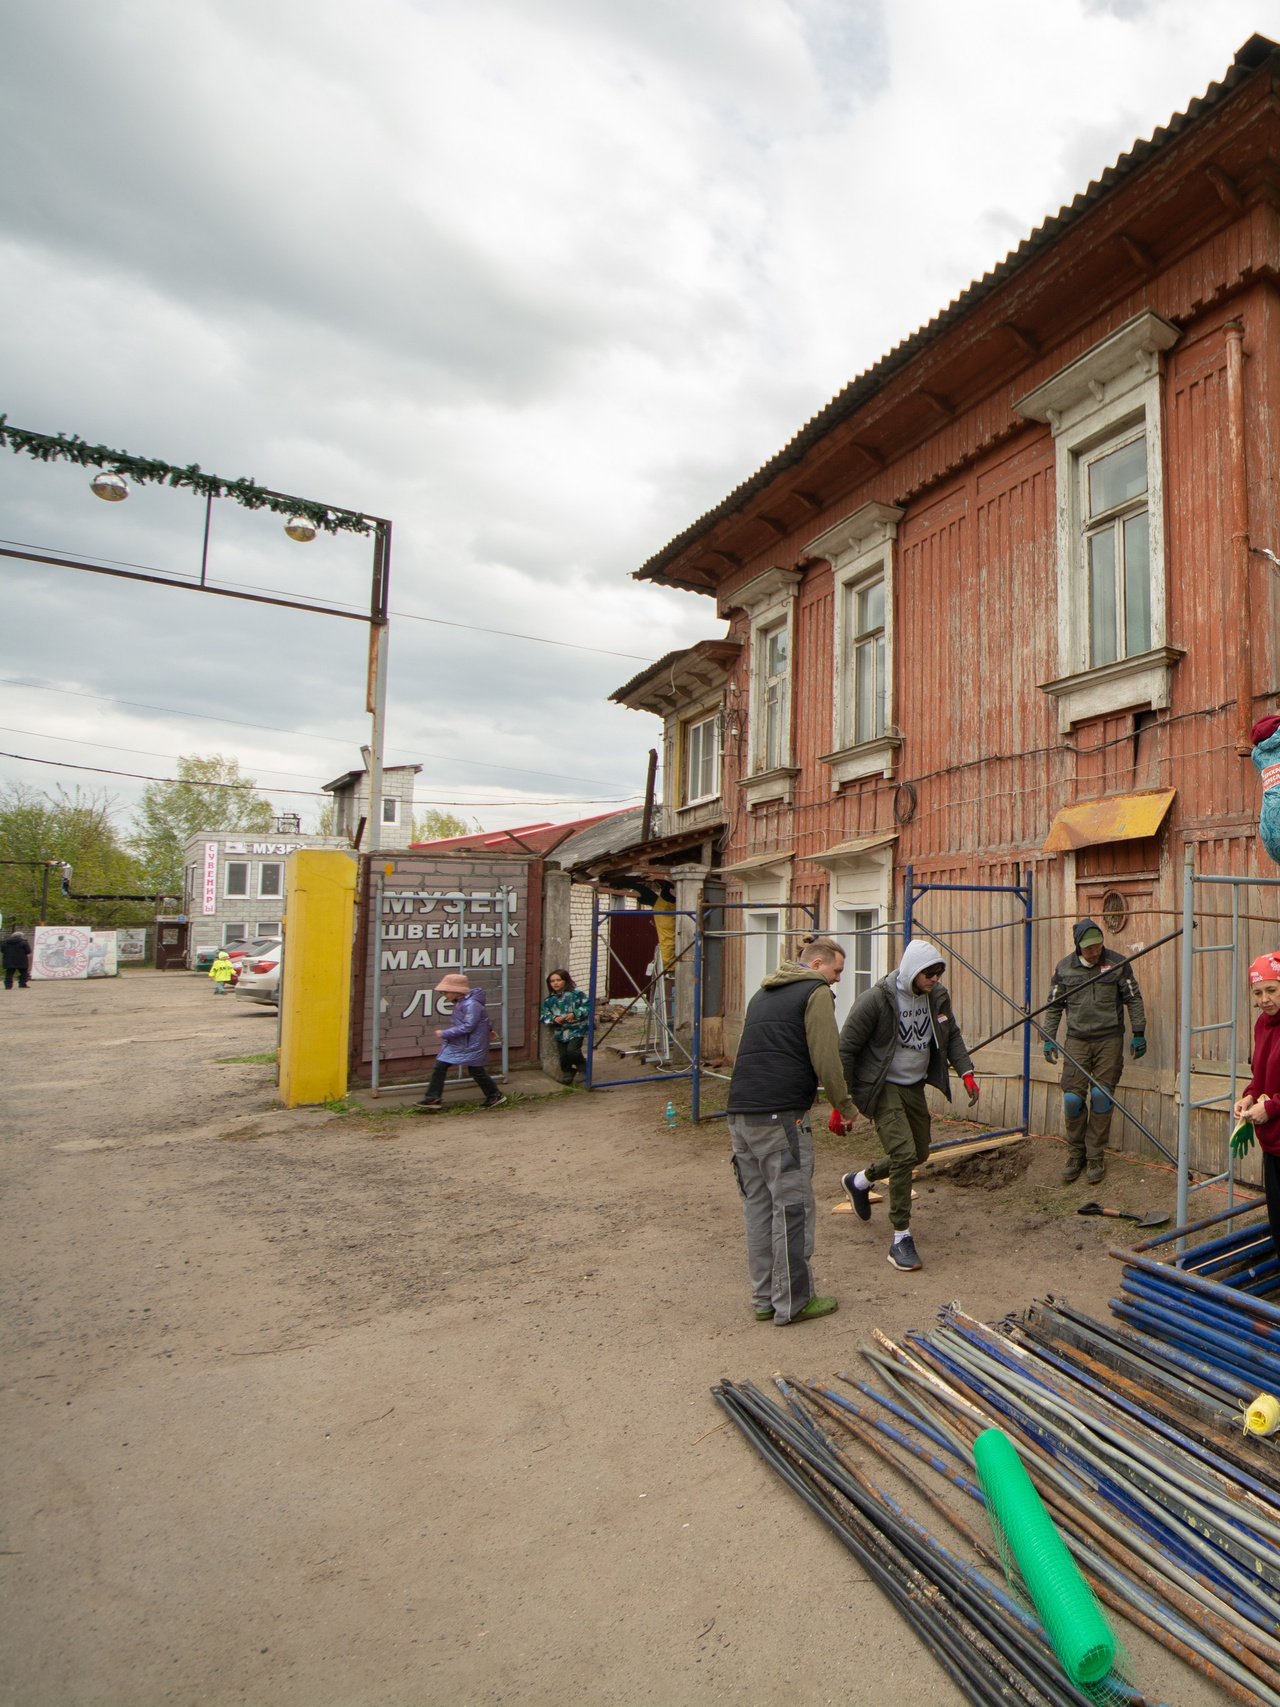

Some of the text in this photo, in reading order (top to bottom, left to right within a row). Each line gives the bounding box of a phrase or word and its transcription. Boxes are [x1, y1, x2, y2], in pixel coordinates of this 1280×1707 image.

[205, 845, 215, 912] СУВЕНИРЫ
[382, 885, 518, 913] МУЗЕЙ
[381, 919, 519, 940] ШВЕЙНЫХ
[381, 947, 515, 970] МАШИН
[401, 989, 456, 1019] Ле
[902, 1041, 927, 1050] WAVE
